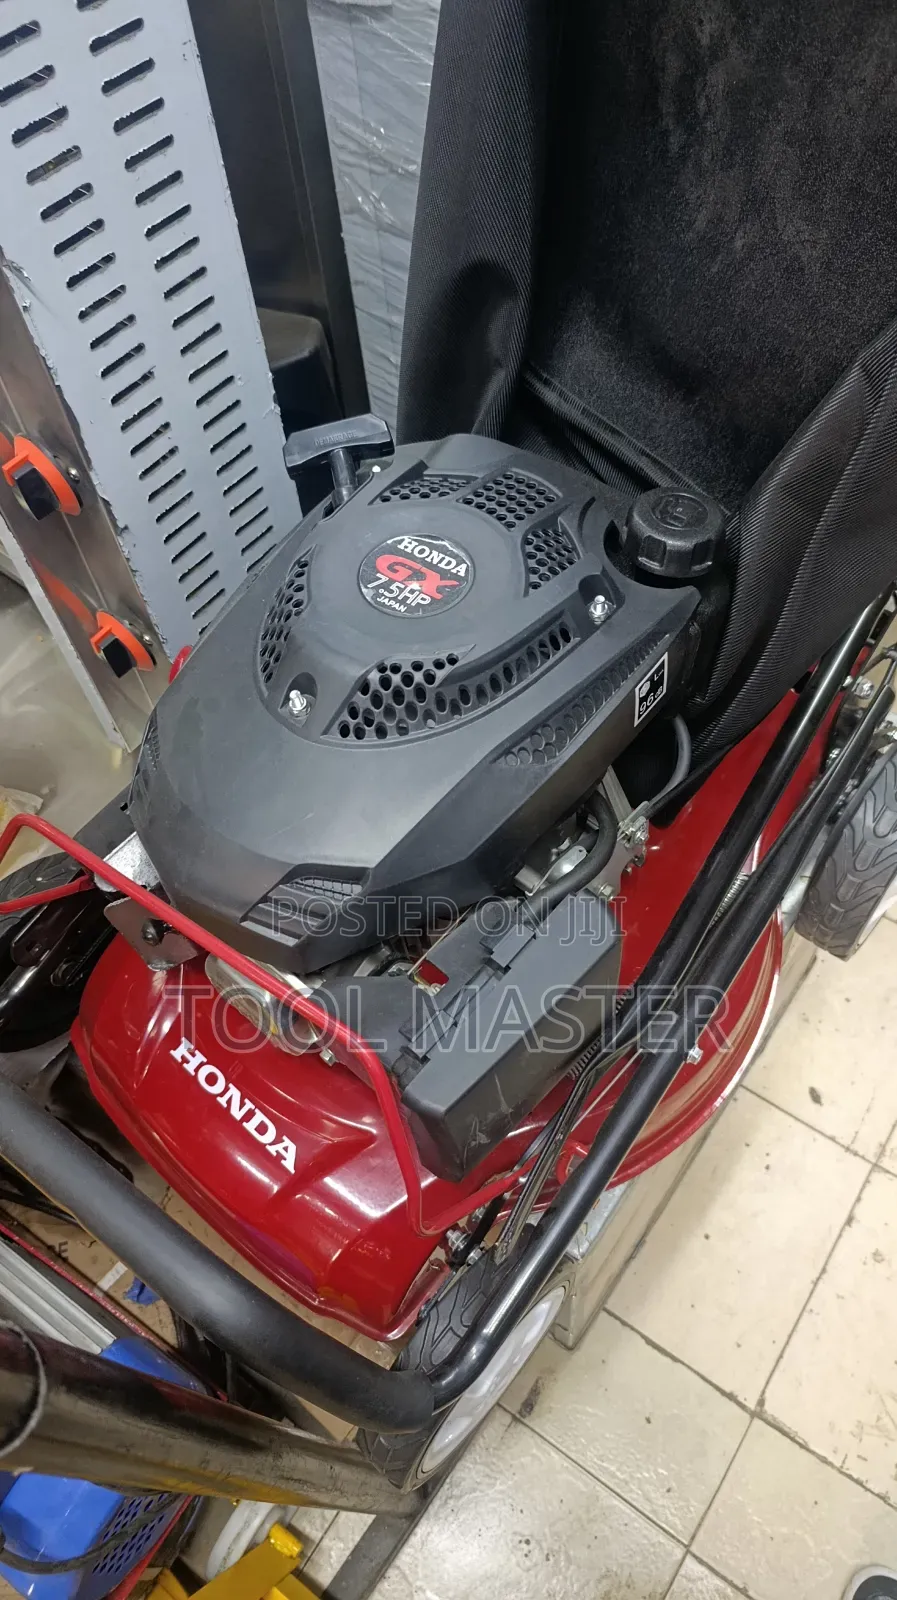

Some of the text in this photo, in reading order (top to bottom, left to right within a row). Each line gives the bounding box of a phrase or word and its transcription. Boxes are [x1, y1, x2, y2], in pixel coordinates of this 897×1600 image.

[396, 537, 469, 577] HONDA
[367, 573, 431, 607] 7.5HP
[375, 554, 460, 600] GX
[376, 596, 408, 613] JAPAN
[640, 693, 655, 714] 96
[169, 1036, 299, 1175] HONDA
